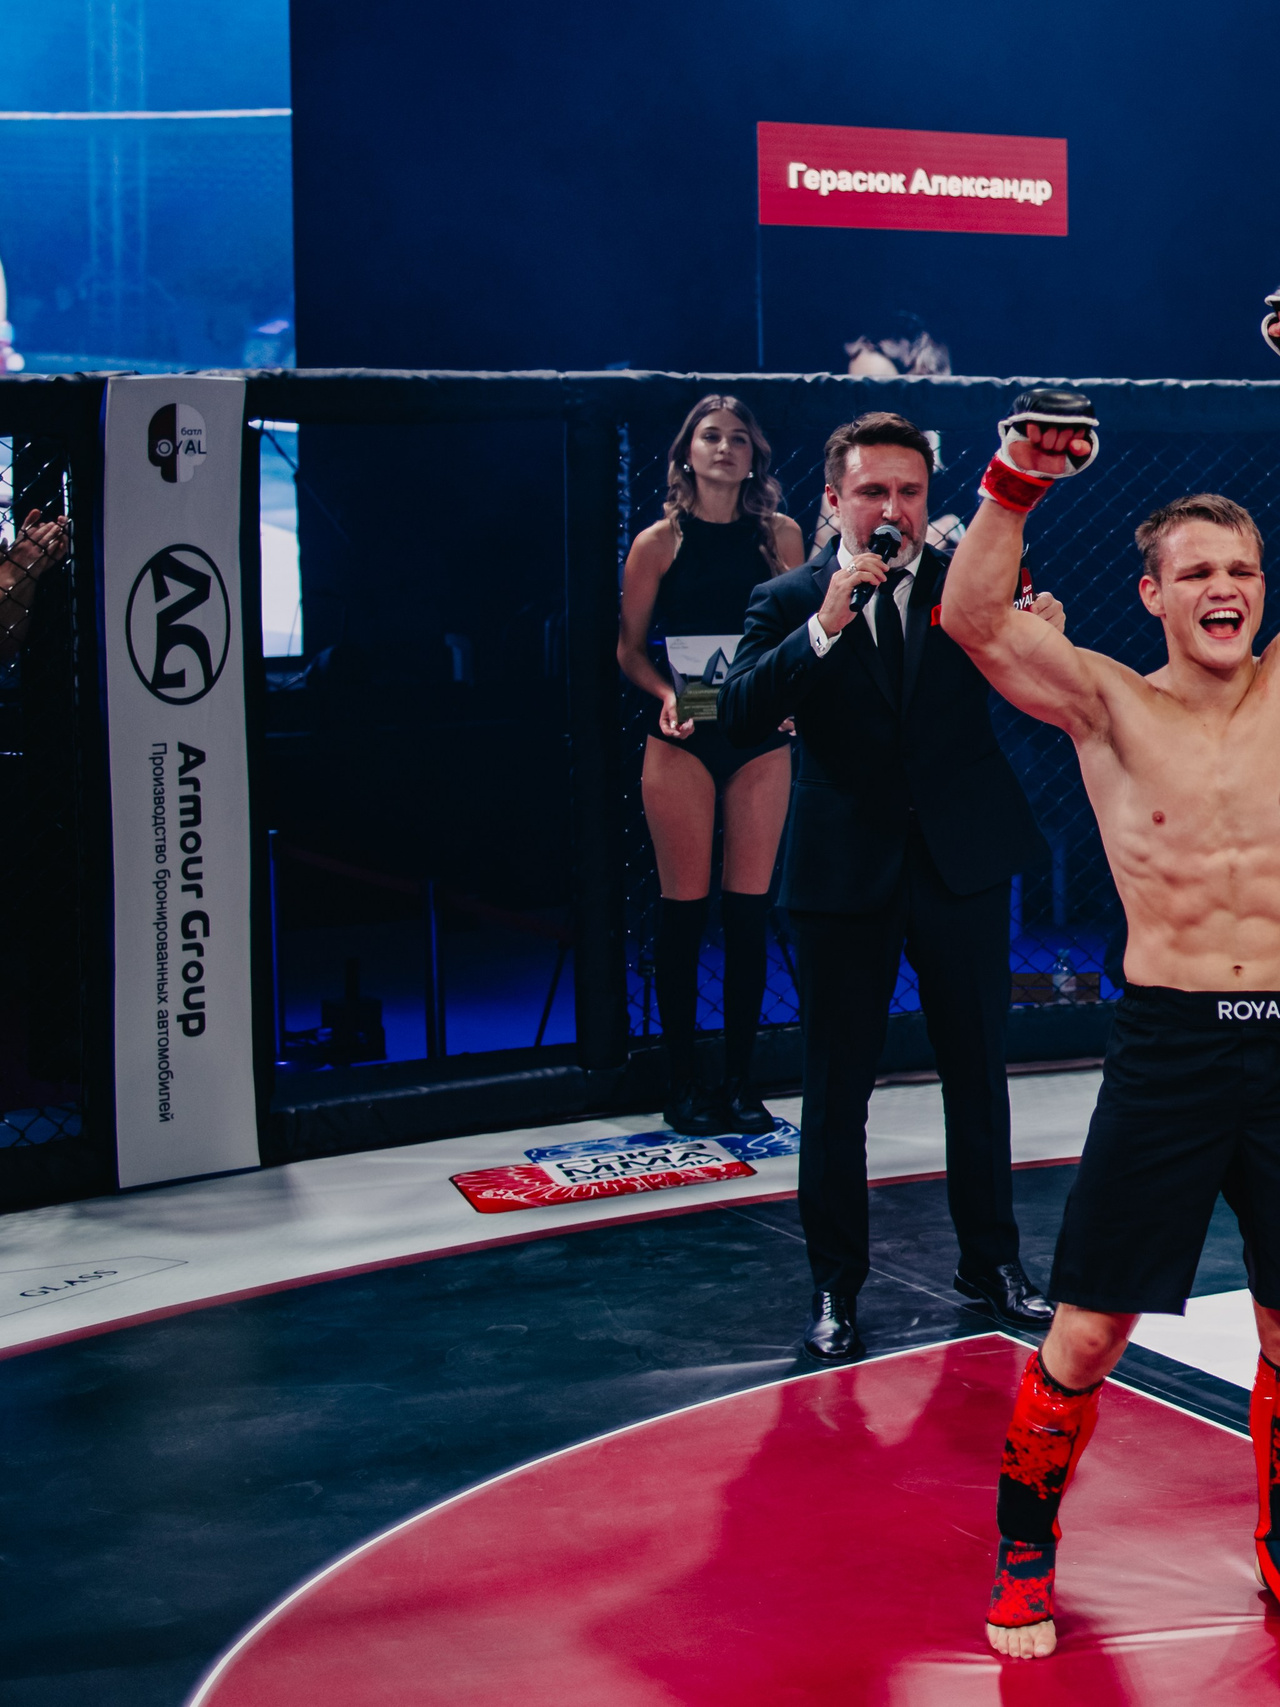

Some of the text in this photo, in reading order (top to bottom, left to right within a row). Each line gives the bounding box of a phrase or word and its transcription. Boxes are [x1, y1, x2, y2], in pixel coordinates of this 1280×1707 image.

[787, 161, 1053, 206] Герасюк Александр
[180, 426, 203, 436] батл
[157, 439, 208, 455] OYAL
[1013, 593, 1034, 609] OYAL
[176, 741, 210, 1038] Armour Group
[148, 742, 174, 1123] Производство бронированных автомобилей
[555, 1142, 708, 1169] СОЮЗ
[561, 1151, 716, 1178] ММА
[569, 1157, 723, 1183] РОССИИ
[19, 1269, 118, 1298] GLASS
